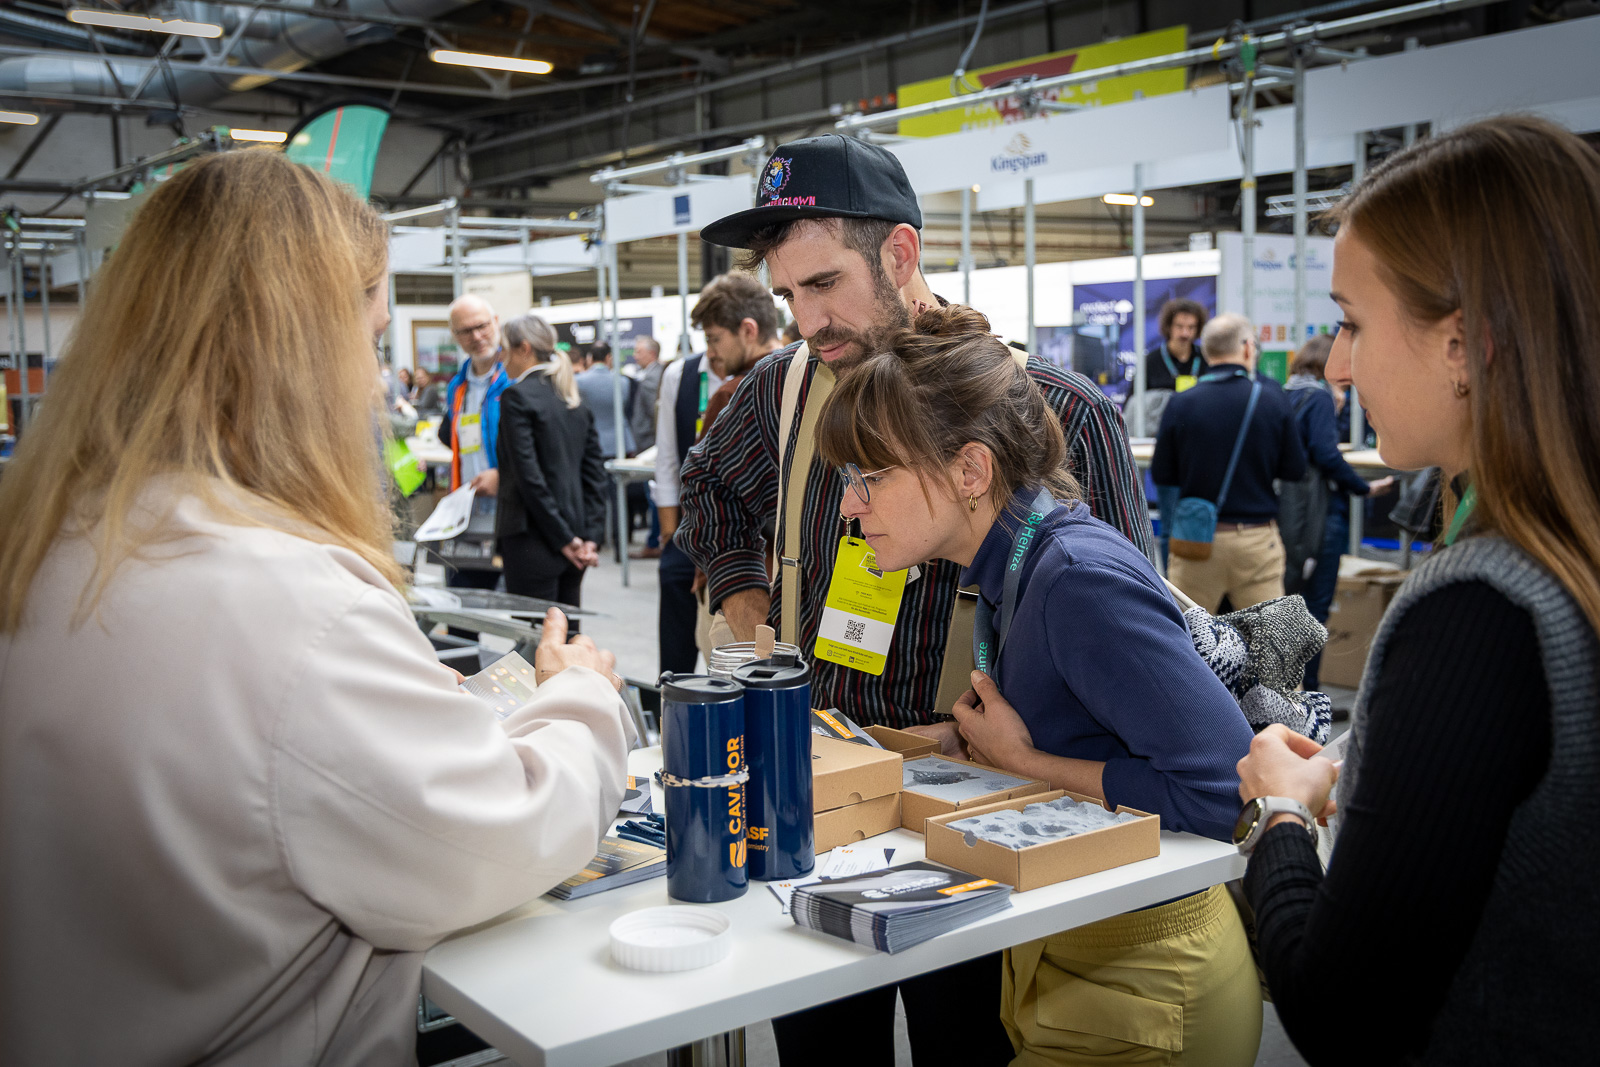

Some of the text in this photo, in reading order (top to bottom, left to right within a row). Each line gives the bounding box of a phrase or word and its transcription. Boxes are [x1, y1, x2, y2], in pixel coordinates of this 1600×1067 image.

[991, 152, 1047, 173] Kingspan
[1009, 526, 1036, 571] Heinze
[977, 642, 988, 673] einze
[747, 843, 769, 852] emistry
